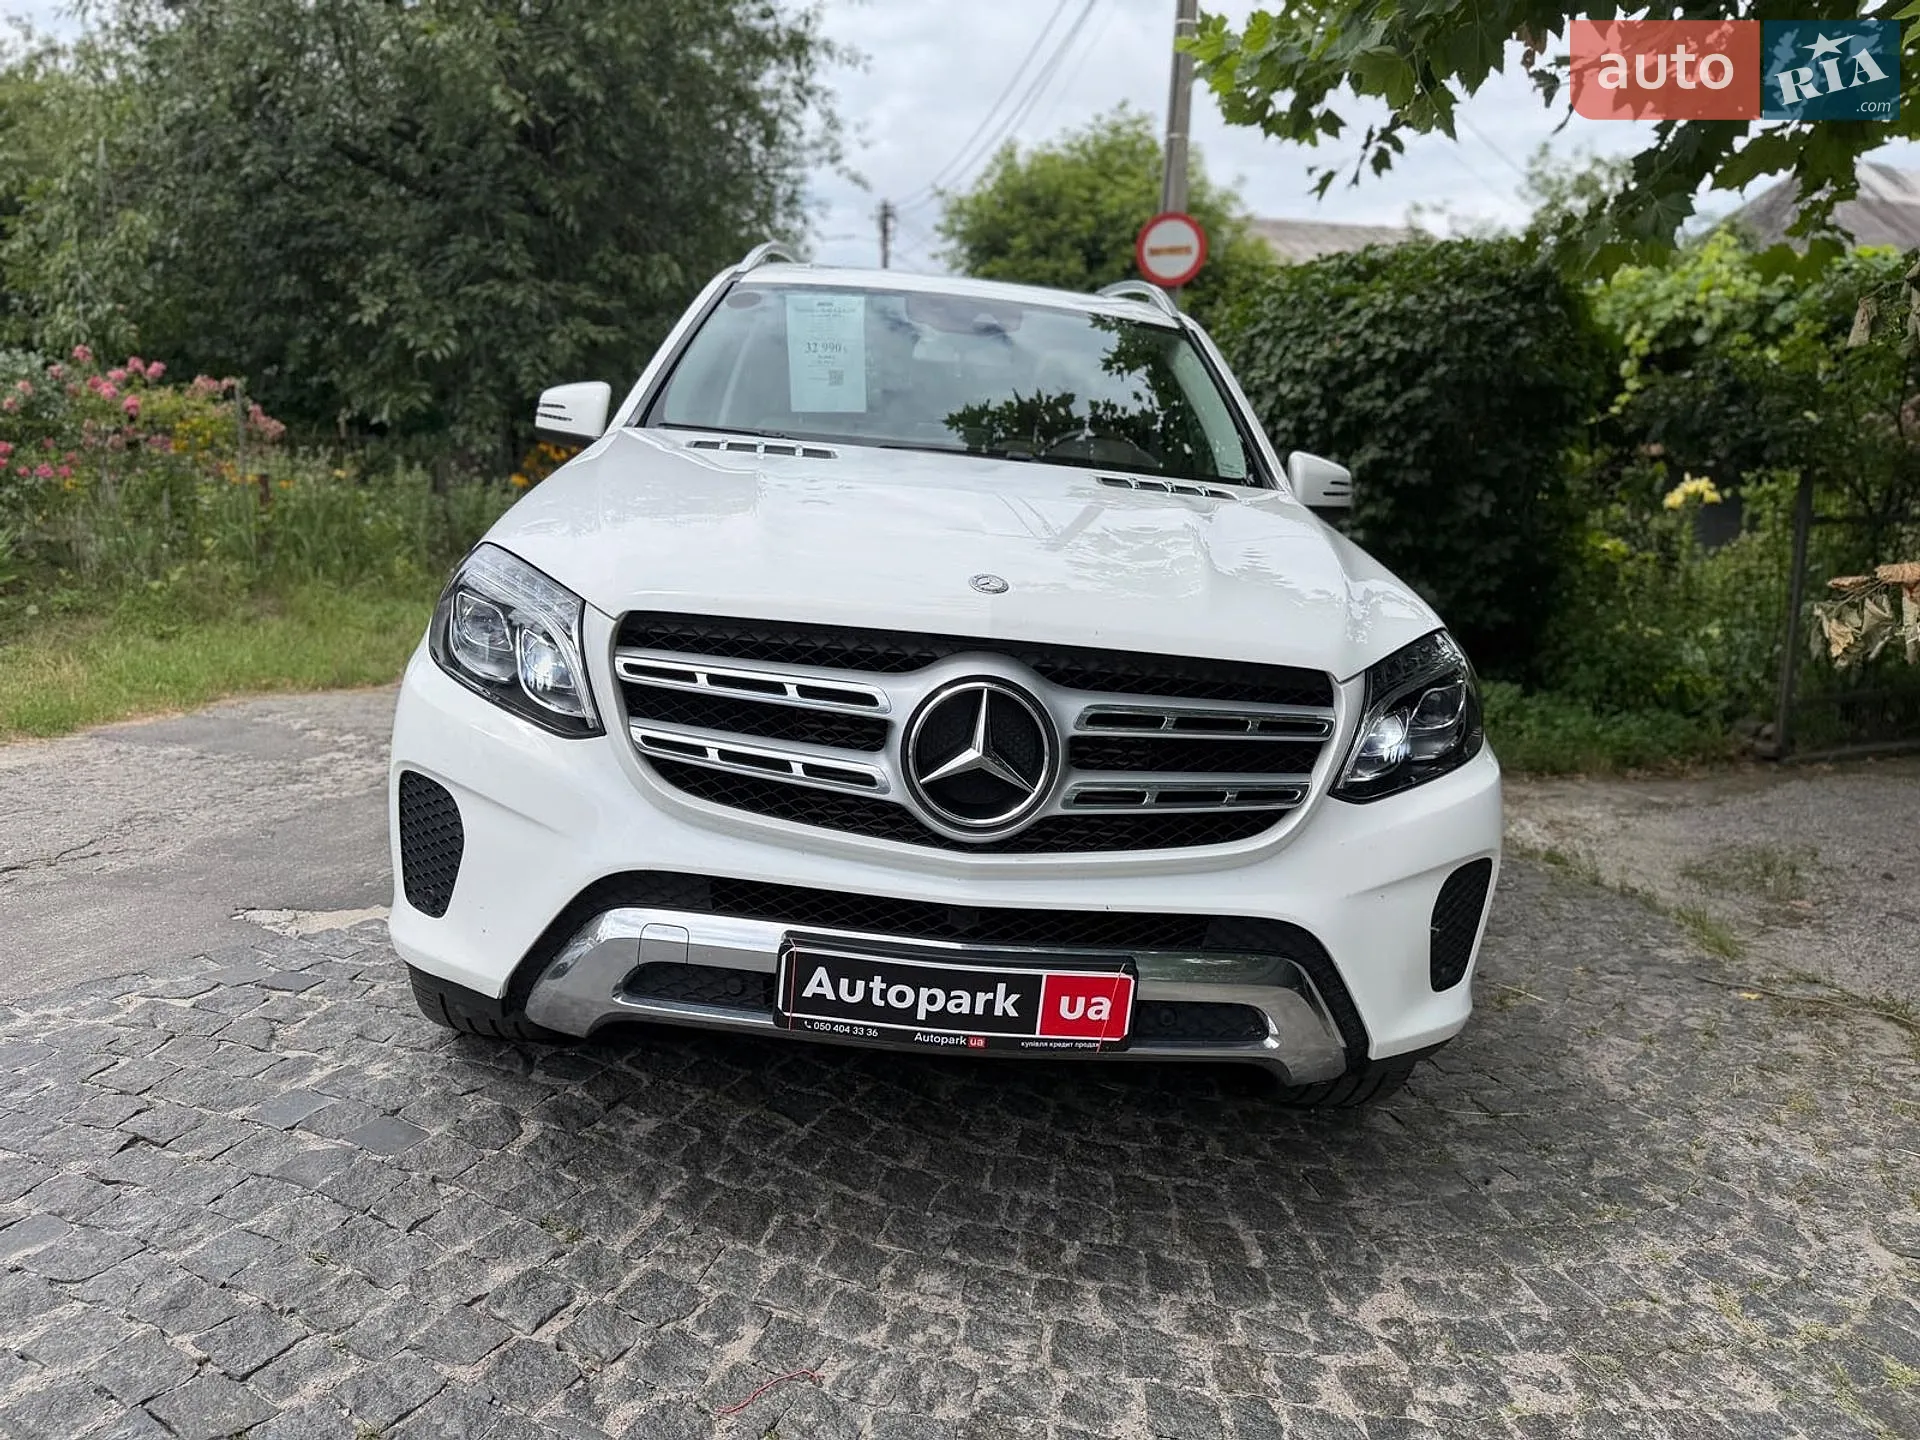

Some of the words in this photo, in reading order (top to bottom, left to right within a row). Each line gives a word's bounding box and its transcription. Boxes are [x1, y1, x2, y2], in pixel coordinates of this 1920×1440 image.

[820, 342, 841, 354] 990
[802, 966, 1021, 1021] Autopark
[1059, 994, 1112, 1021] ua
[813, 1021, 831, 1031] 050
[833, 1024, 850, 1034] 404
[852, 1027, 864, 1036] 33
[866, 1029, 879, 1037] 36
[914, 1032, 967, 1047] Autopark
[969, 1038, 985, 1047] ua
[1021, 1040, 1048, 1049] купівля
[1049, 1041, 1073, 1050] кредит
